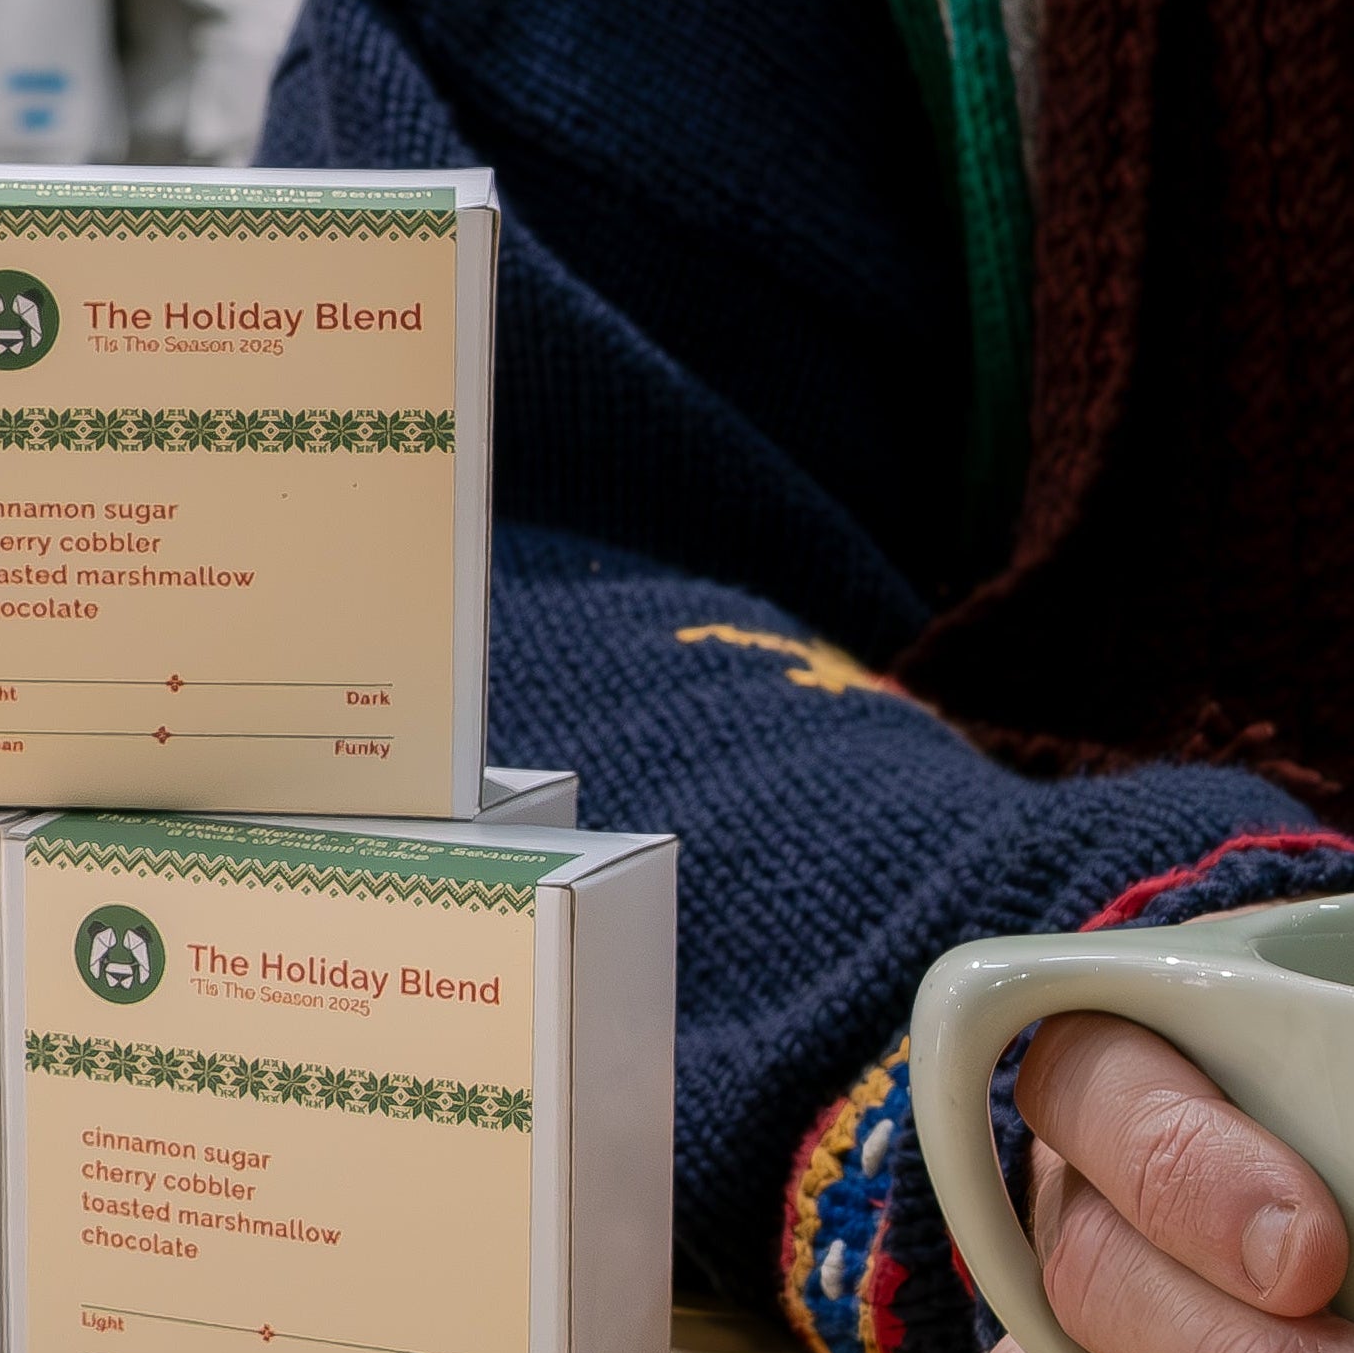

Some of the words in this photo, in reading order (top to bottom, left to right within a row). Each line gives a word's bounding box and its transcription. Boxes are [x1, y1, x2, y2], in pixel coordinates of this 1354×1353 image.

[85, 302, 151, 330] The
[164, 302, 302, 337] Holiday
[316, 303, 422, 331] Blend
[124, 335, 160, 353] The
[165, 336, 234, 353] Season
[239, 339, 283, 356] 2025
[105, 504, 176, 524] sugar
[59, 533, 159, 553] cobbler
[77, 567, 254, 587] marshmallow
[345, 691, 390, 705] Dark
[334, 741, 390, 758] Funky
[188, 944, 249, 977] The
[261, 952, 388, 999] Holiday
[400, 967, 500, 1005] Blend
[261, 986, 324, 1007] Season
[330, 998, 371, 1016] 2025
[81, 1130, 197, 1158] cinnamon
[204, 1147, 270, 1171] sugar
[81, 1161, 156, 1192] cherry
[163, 1174, 255, 1200] cobbler
[82, 1191, 171, 1222] toasted
[177, 1210, 340, 1244] marshmallow
[80, 1227, 199, 1259] chocolate
[81, 1312, 124, 1332] Light
